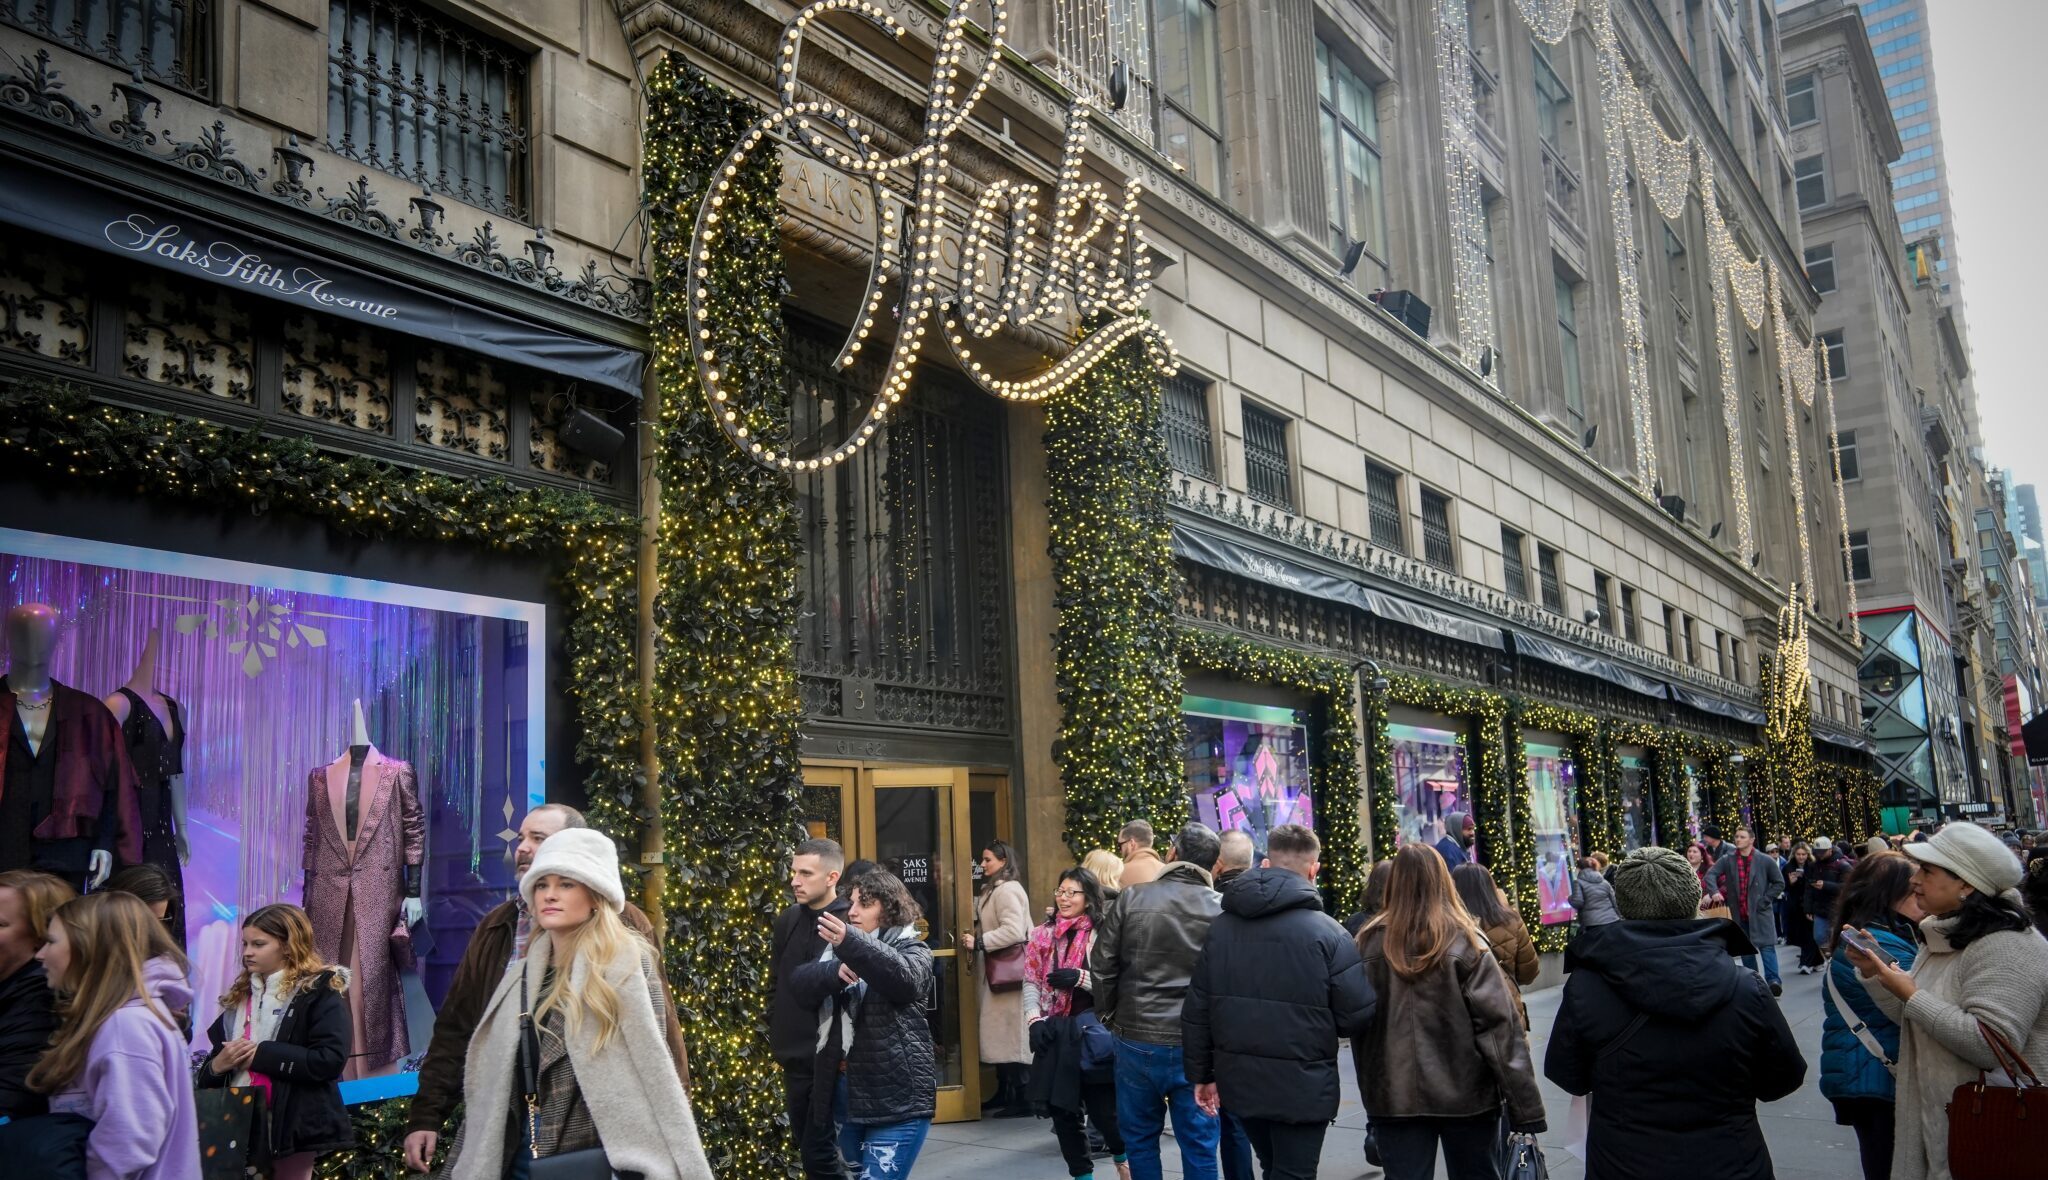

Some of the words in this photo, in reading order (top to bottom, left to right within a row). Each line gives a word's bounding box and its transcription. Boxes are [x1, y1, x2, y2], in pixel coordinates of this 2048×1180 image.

[779, 161, 865, 225] AKS
[104, 213, 210, 268] Saks
[201, 241, 289, 291] Fifth
[854, 689, 865, 710] 3
[1959, 803, 1989, 814] PUMA
[903, 858, 927, 869] SAKS
[903, 868, 928, 877] FIFTH
